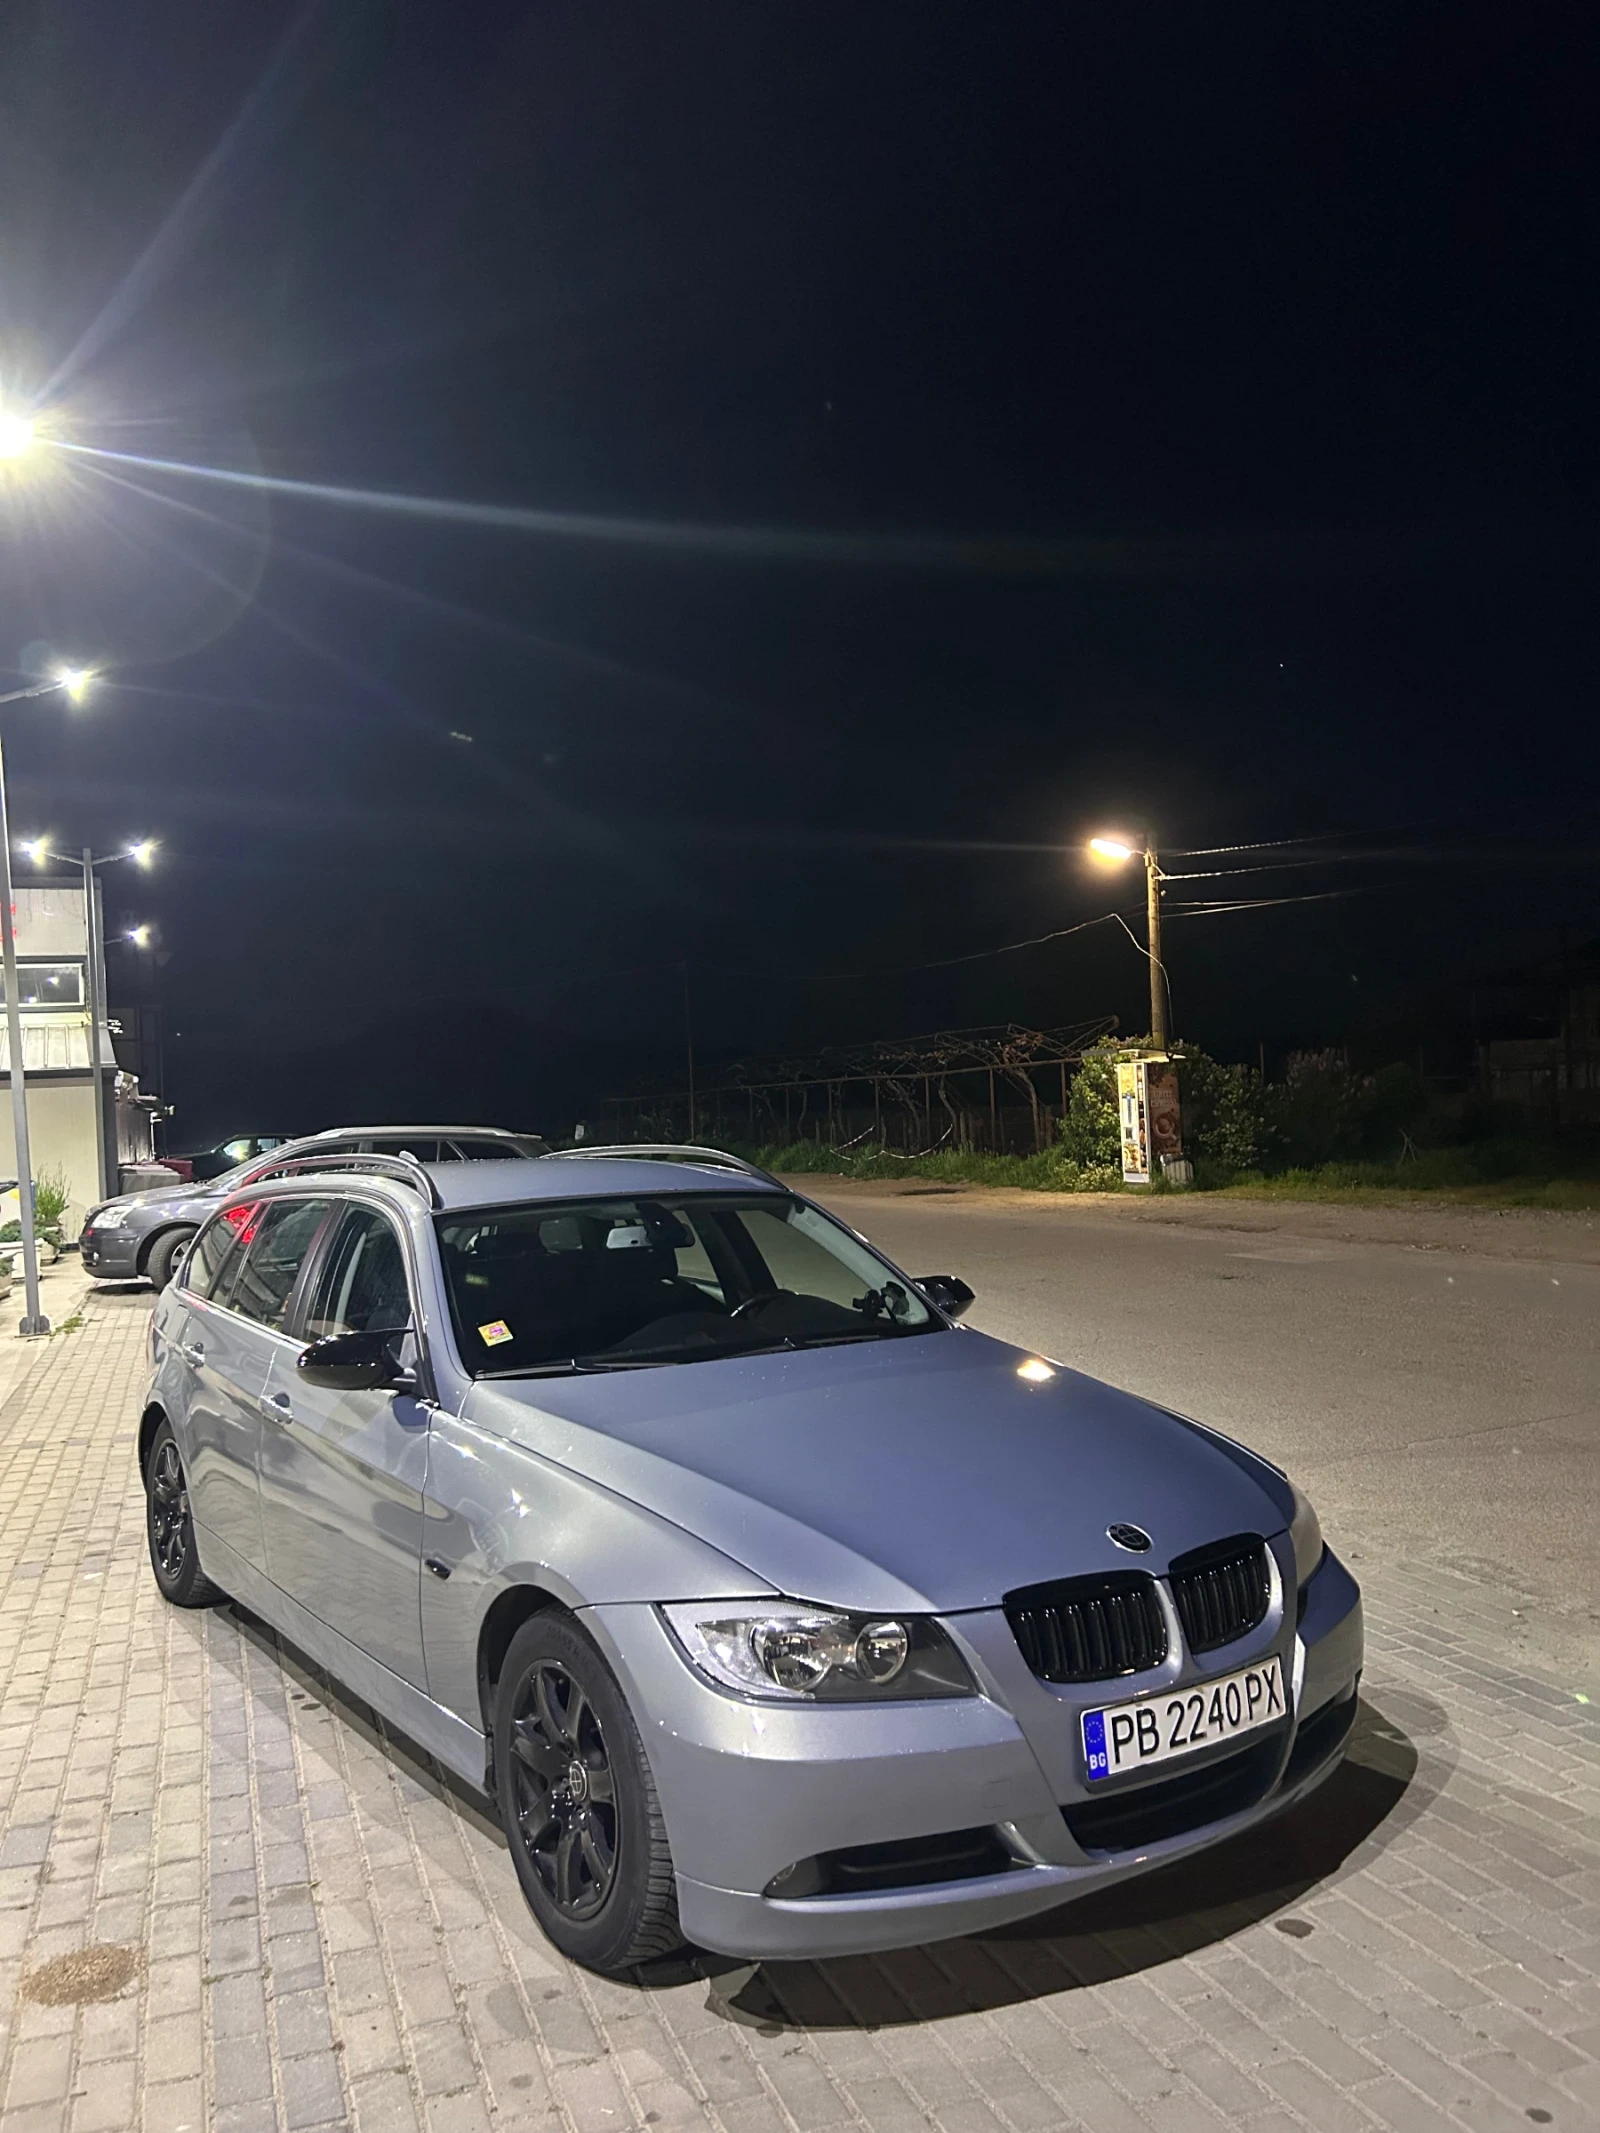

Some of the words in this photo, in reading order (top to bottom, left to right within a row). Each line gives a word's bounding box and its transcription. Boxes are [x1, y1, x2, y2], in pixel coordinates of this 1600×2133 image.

[1111, 1708, 1160, 1765] PB
[1166, 1681, 1241, 1749] 2240
[1244, 1665, 1281, 1721] PX
[1089, 1752, 1107, 1770] BG
